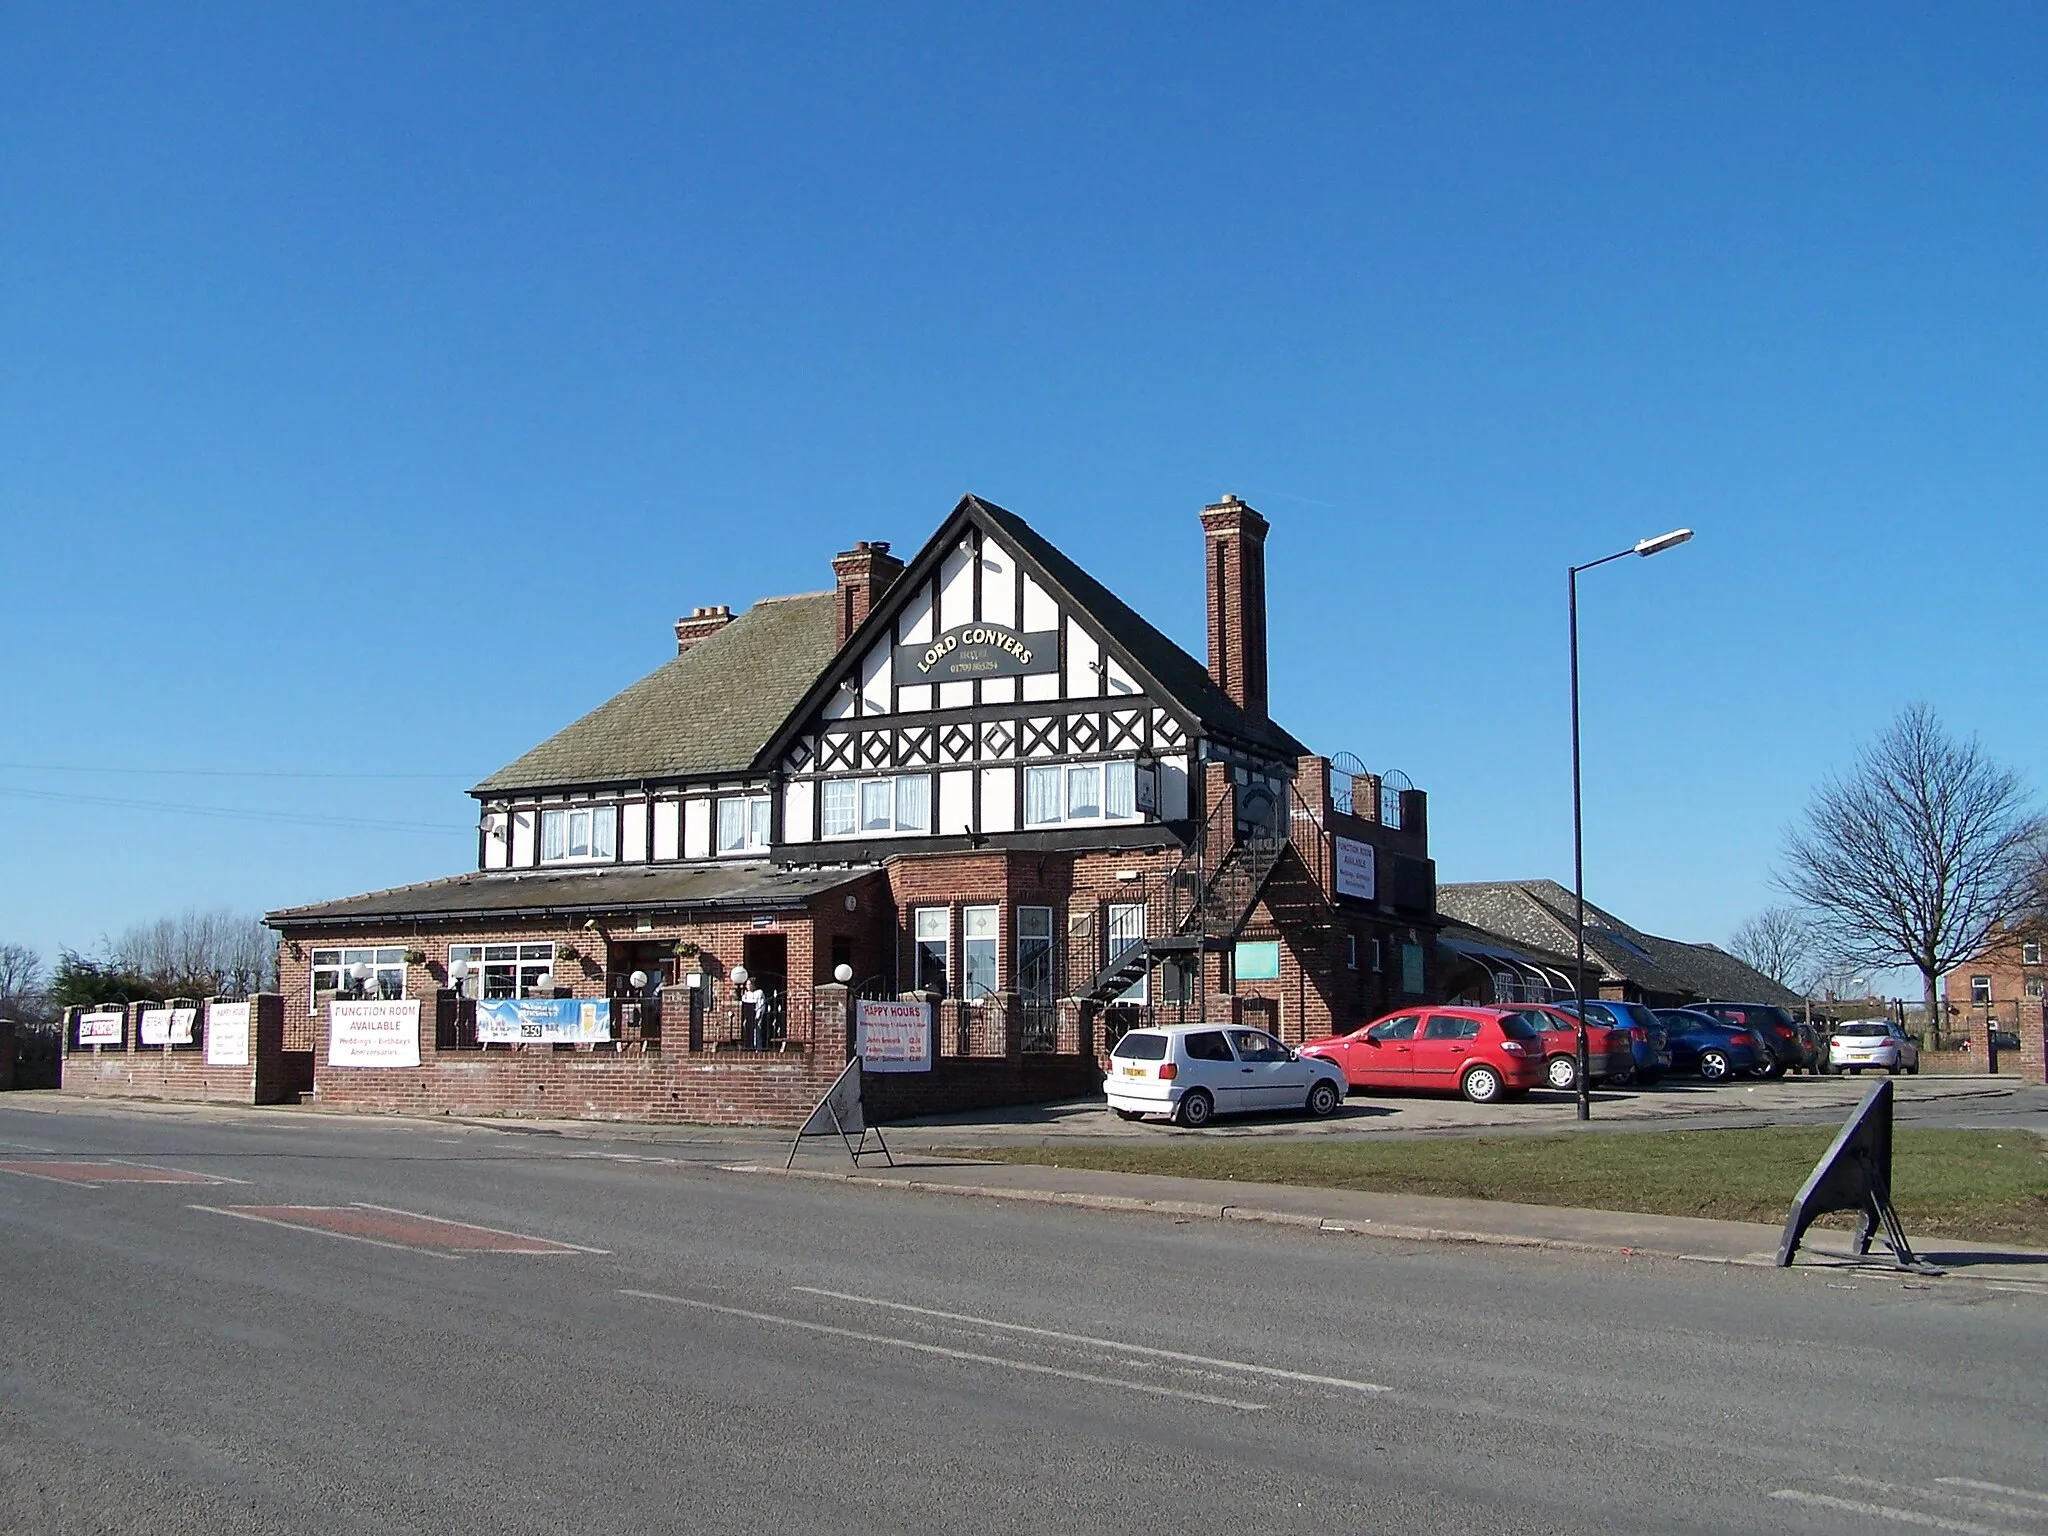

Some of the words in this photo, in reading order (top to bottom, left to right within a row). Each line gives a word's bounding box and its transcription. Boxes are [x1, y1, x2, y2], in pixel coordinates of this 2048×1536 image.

[917, 635, 957, 673] LORD
[962, 628, 1033, 664] CONYERS
[335, 1006, 386, 1016] FUNCTION
[389, 1006, 416, 1016] ROOM
[864, 1005, 888, 1017] HAPPY
[890, 1007, 921, 1017] HOURS
[350, 1021, 401, 1031] AVAILABLE
[339, 1038, 372, 1046] Weddings
